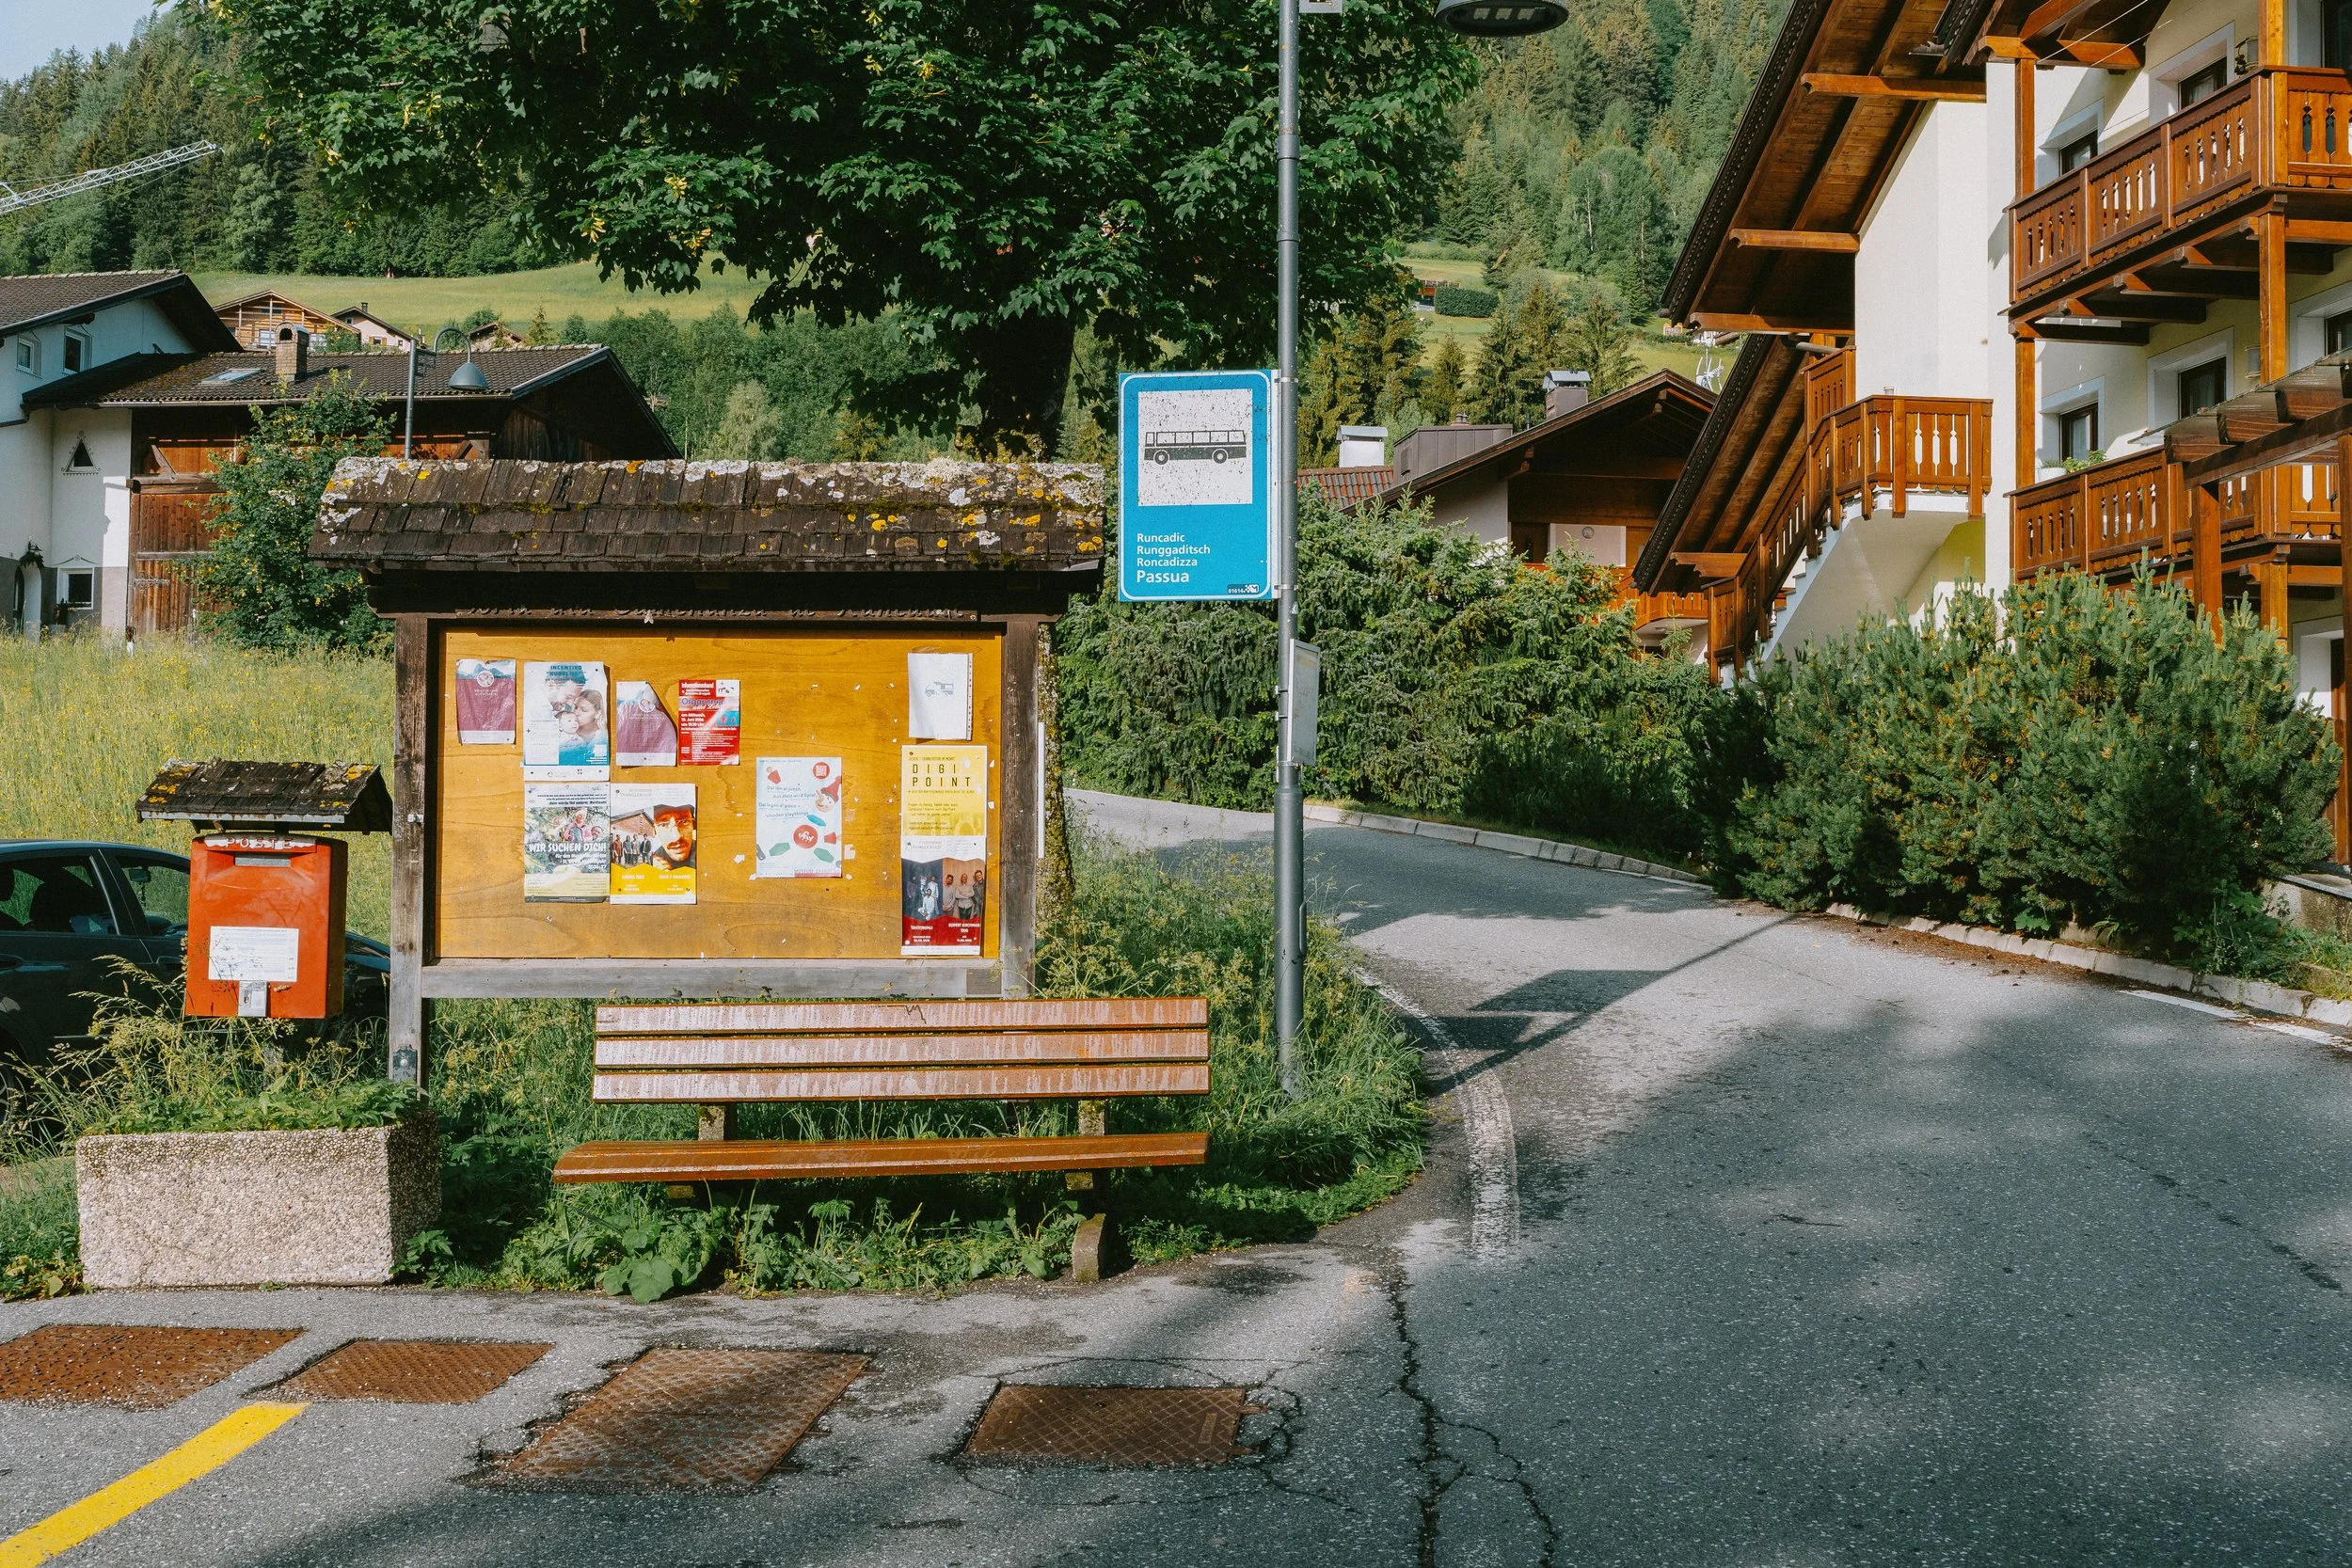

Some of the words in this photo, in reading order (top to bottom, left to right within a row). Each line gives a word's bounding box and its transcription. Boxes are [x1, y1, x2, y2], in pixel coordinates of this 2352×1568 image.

[1136, 532, 1185, 543] Runcadic
[1136, 545, 1211, 558] Runggaditsch
[1136, 557, 1198, 567] Roncadizza
[1136, 570, 1190, 583] Passua
[913, 764, 956, 774] DIGI
[913, 777, 971, 787] POINT
[226, 836, 294, 849] POSTE
[529, 843, 547, 852] WIR
[548, 843, 581, 852] SUCHEN
[583, 842, 607, 852] DICH!
